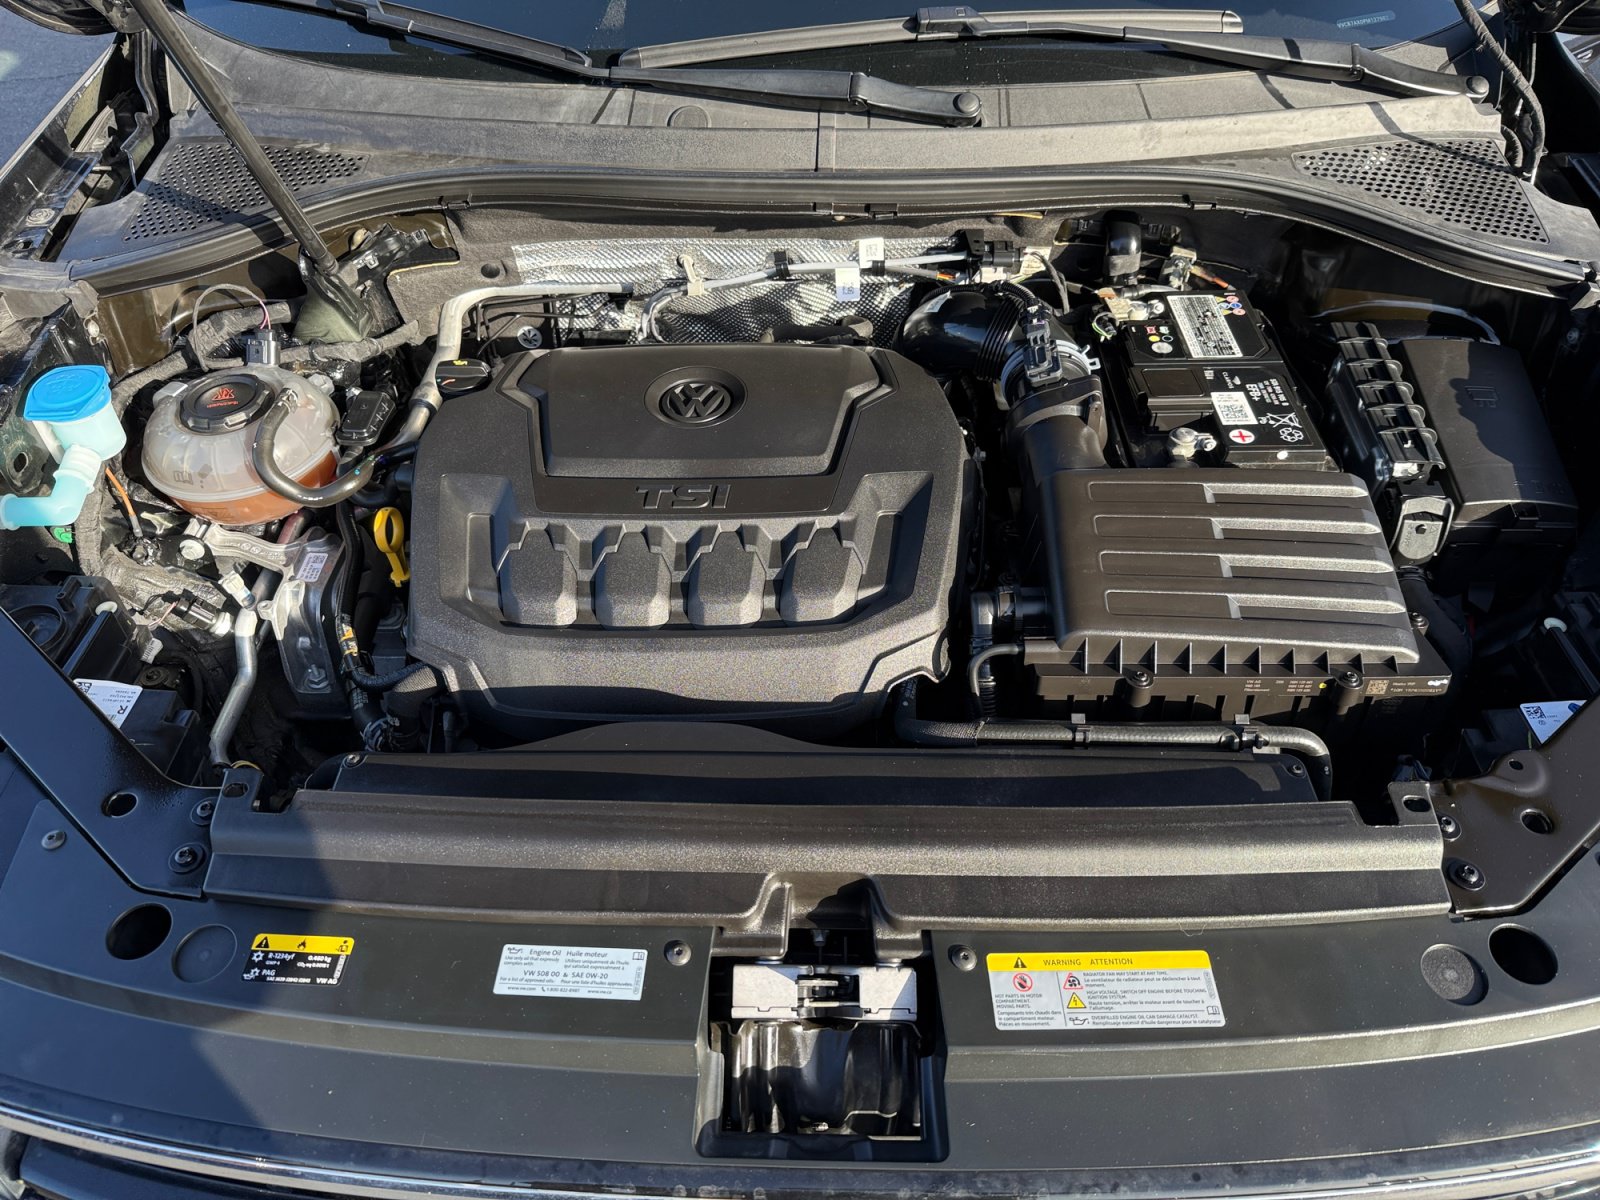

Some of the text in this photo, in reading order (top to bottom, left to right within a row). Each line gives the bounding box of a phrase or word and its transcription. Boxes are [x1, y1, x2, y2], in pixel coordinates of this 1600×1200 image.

[1245, 383, 1261, 401] EFB+
[660, 380, 730, 422] VW
[636, 484, 731, 509] TSI
[117, 705, 129, 715] R
[268, 953, 295, 961] R-1234yf
[529, 949, 551, 957] Engine
[1090, 958, 1133, 966] ATTENTION
